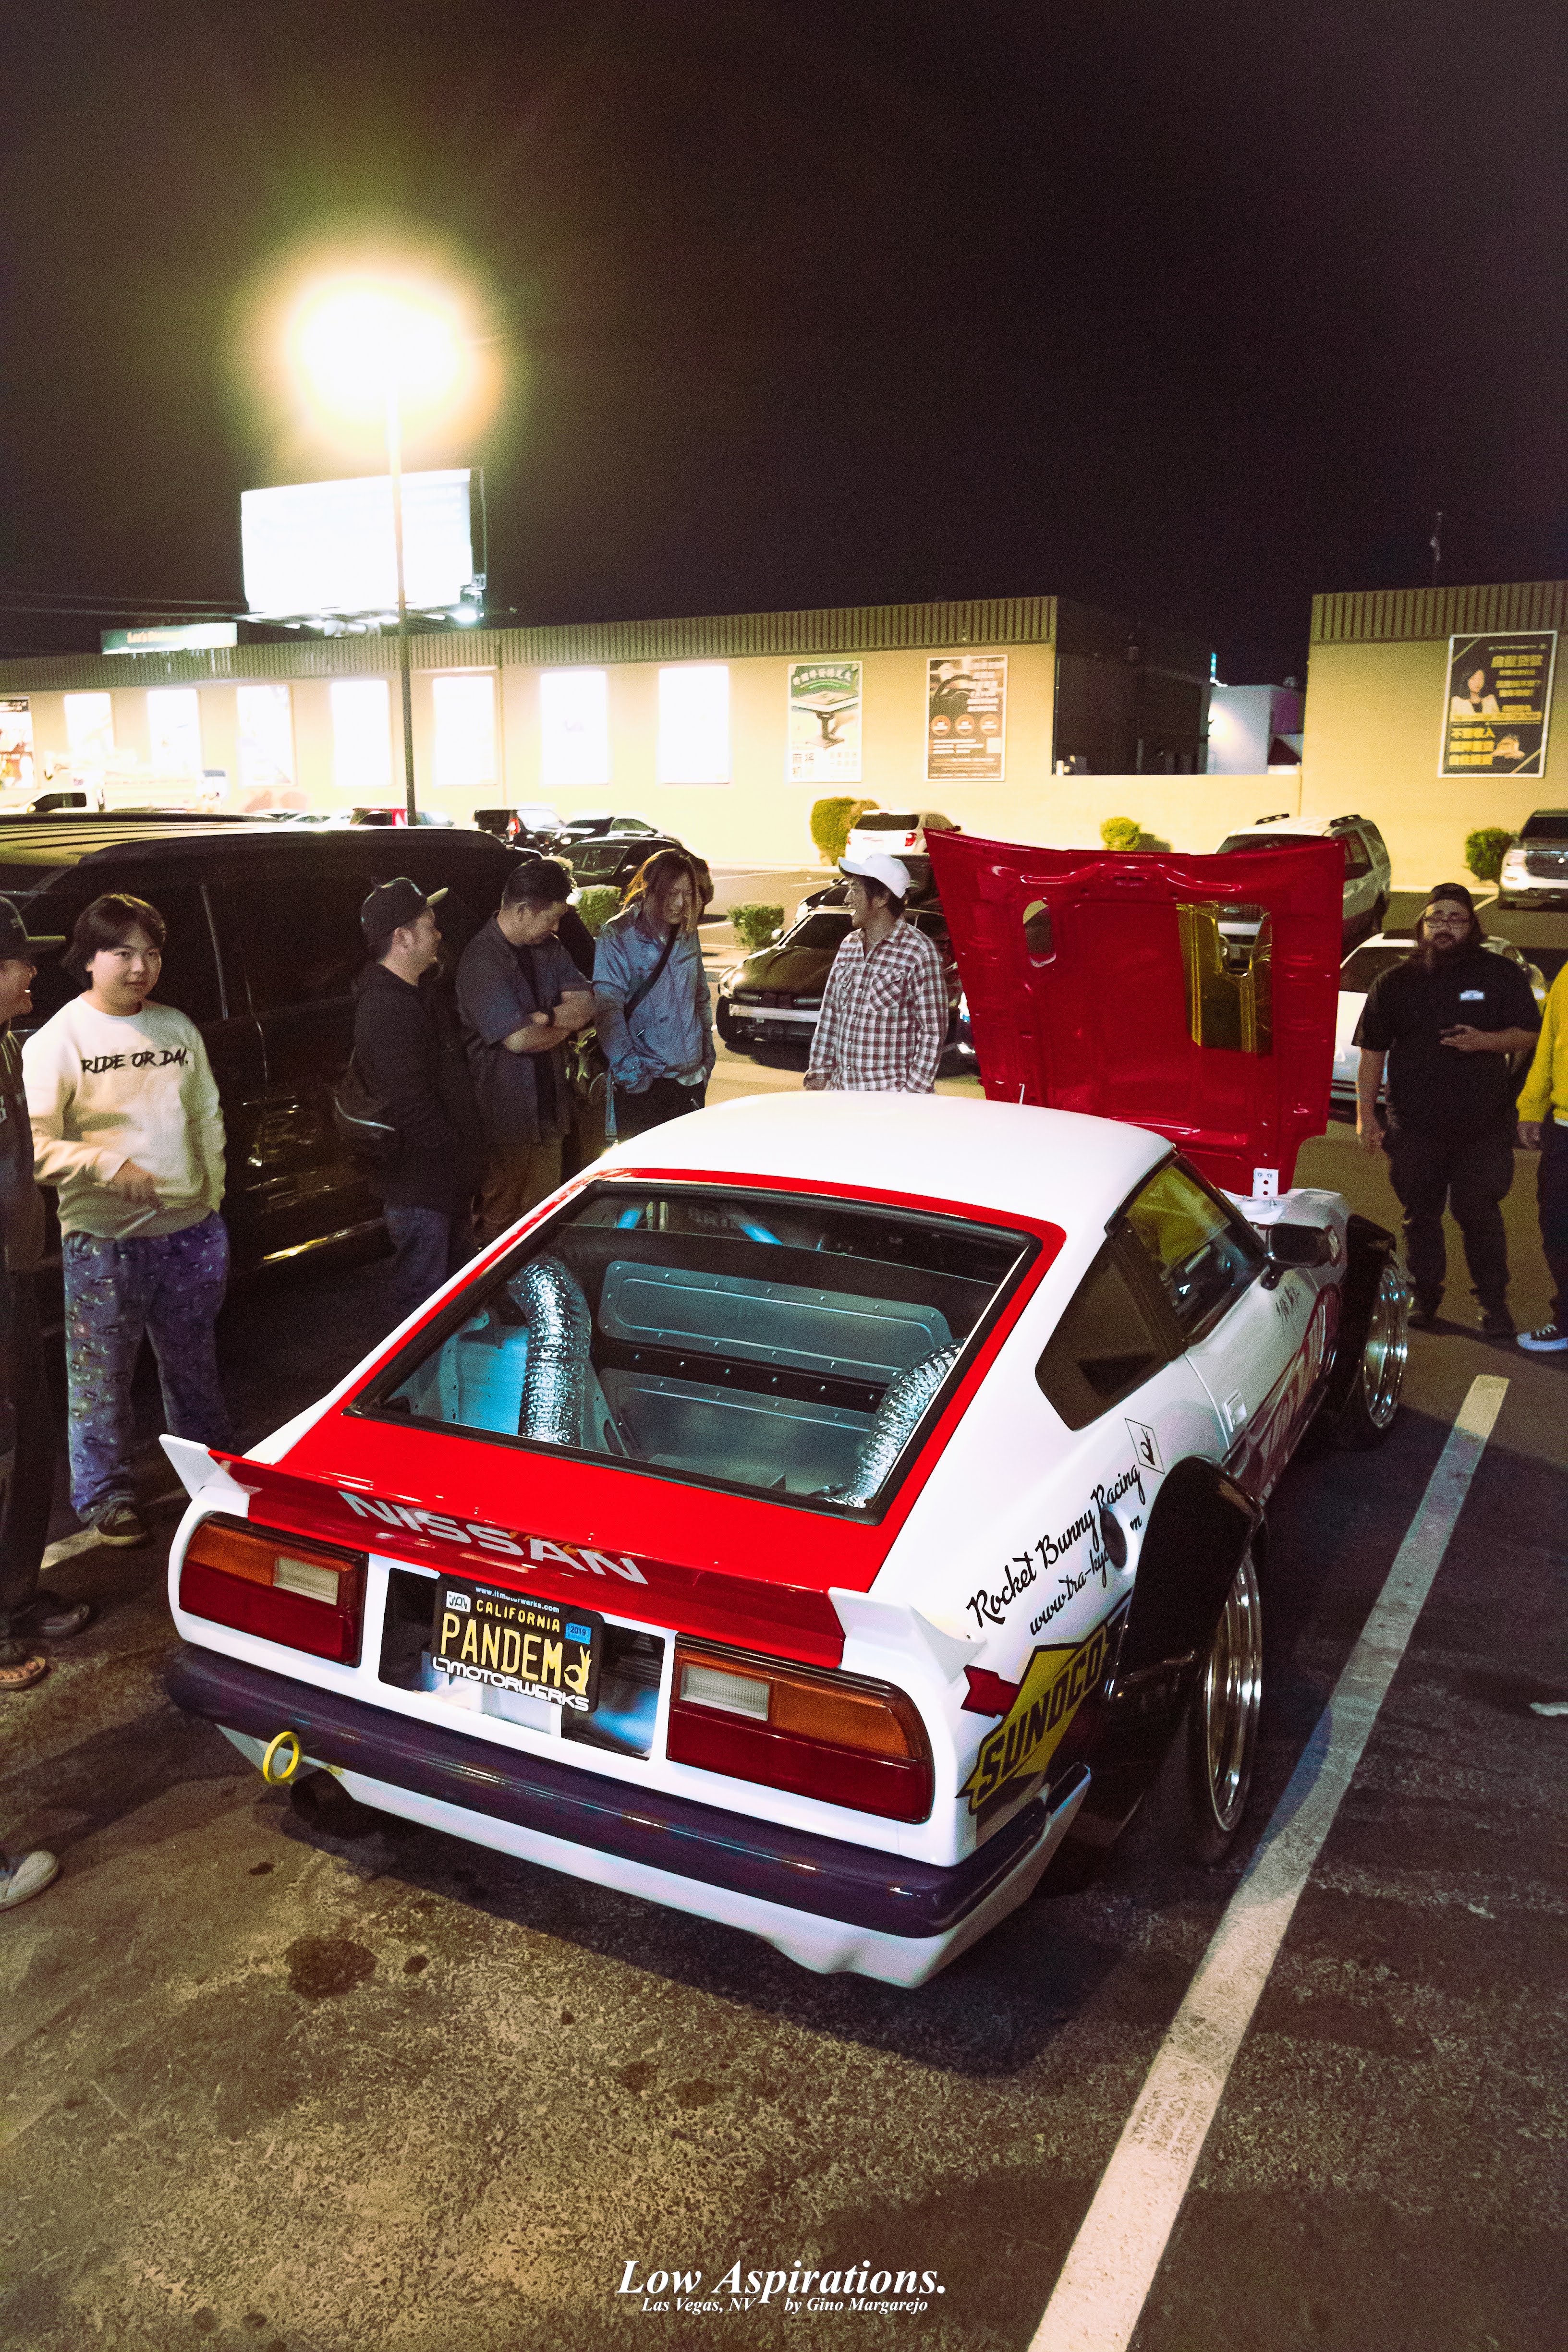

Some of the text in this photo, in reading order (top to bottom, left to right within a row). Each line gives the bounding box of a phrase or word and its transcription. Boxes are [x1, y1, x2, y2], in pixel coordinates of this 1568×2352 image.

[81, 1054, 126, 1074] RIDE
[130, 1050, 158, 1067] OR
[338, 1491, 648, 1584] NISSAN
[966, 1464, 1145, 1628] Rocket Bunny Racing
[440, 1612, 563, 1687] PANDEM
[476, 1599, 560, 1632] CALIFORNIA
[570, 1625, 586, 1636] 2019
[977, 1638, 1103, 1801] SUNOCO
